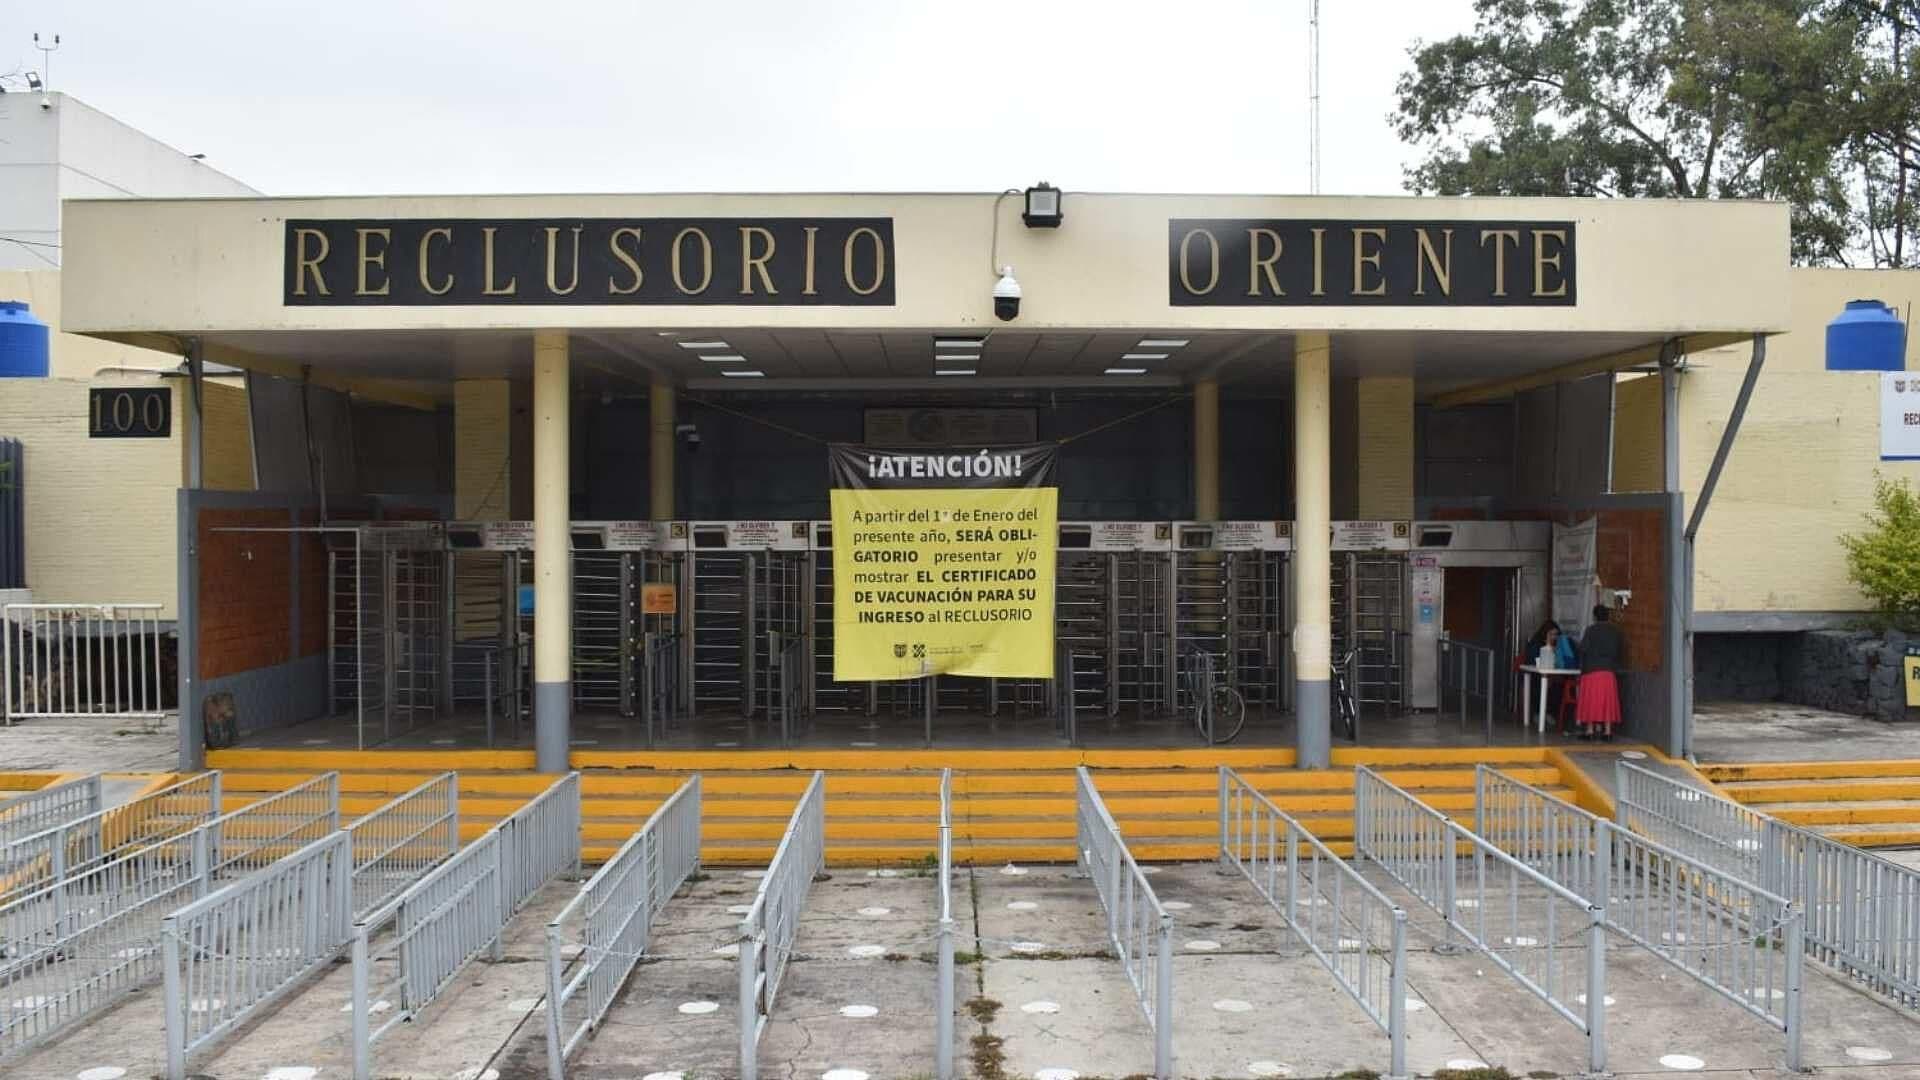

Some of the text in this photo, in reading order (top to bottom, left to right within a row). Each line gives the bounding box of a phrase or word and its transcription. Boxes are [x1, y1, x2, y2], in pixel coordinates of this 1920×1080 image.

[292, 226, 886, 295] RECLUSORIO
[1178, 227, 1567, 297] ORIENTE
[93, 392, 164, 432] 100
[1904, 412, 1920, 425] REC
[868, 449, 1022, 478] ¡ATENCIÓN!
[853, 510, 863, 521] A
[865, 509, 905, 525] partir
[908, 508, 929, 521] del
[953, 508, 970, 521] de
[973, 509, 1014, 521] Enero
[1017, 507, 1038, 521] del
[854, 526, 1038, 546] presente año, SERÁ OBLI-
[1397, 524, 1407, 536] 9
[854, 548, 1037, 565] GATORIO presentar y/o
[854, 568, 1036, 583] mostrar EL CERTIFICADO
[855, 587, 1036, 603] DE VACUNACIÓN PARA SU
[859, 608, 1032, 623] INGRESO al RECLUSORIO
